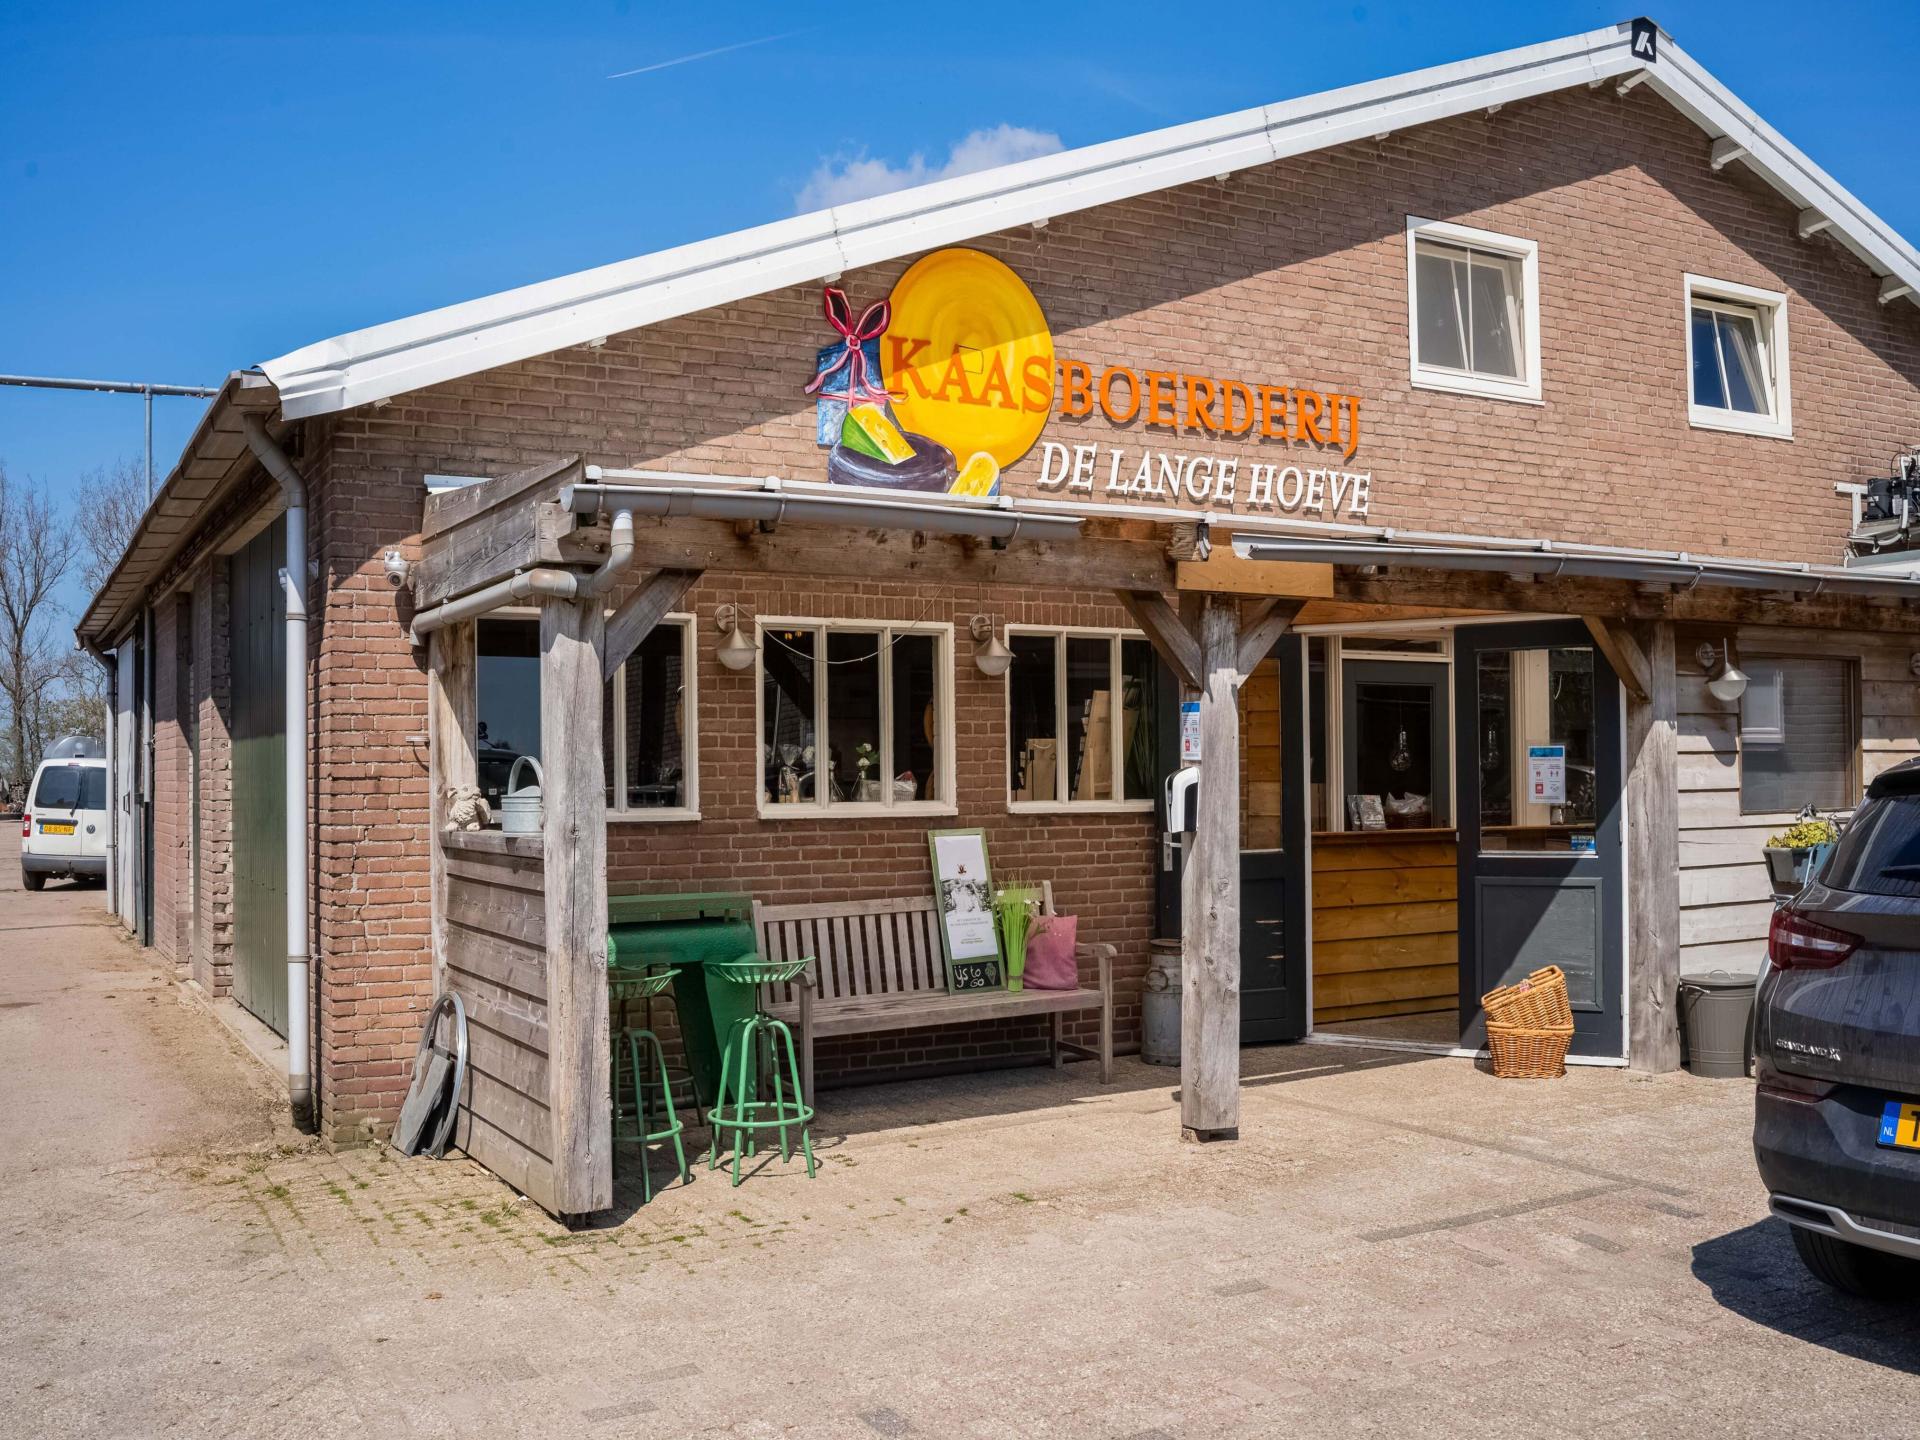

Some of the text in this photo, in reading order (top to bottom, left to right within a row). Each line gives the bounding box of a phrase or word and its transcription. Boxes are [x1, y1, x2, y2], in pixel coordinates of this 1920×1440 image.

[886, 335, 1361, 459] KAASBOERDERIJ
[1036, 441, 1372, 516] DE LANGE HOEVE
[970, 965, 982, 978] to
[1776, 1038, 1828, 1057] GRANDLAND
[1883, 1126, 1894, 1137] NL
